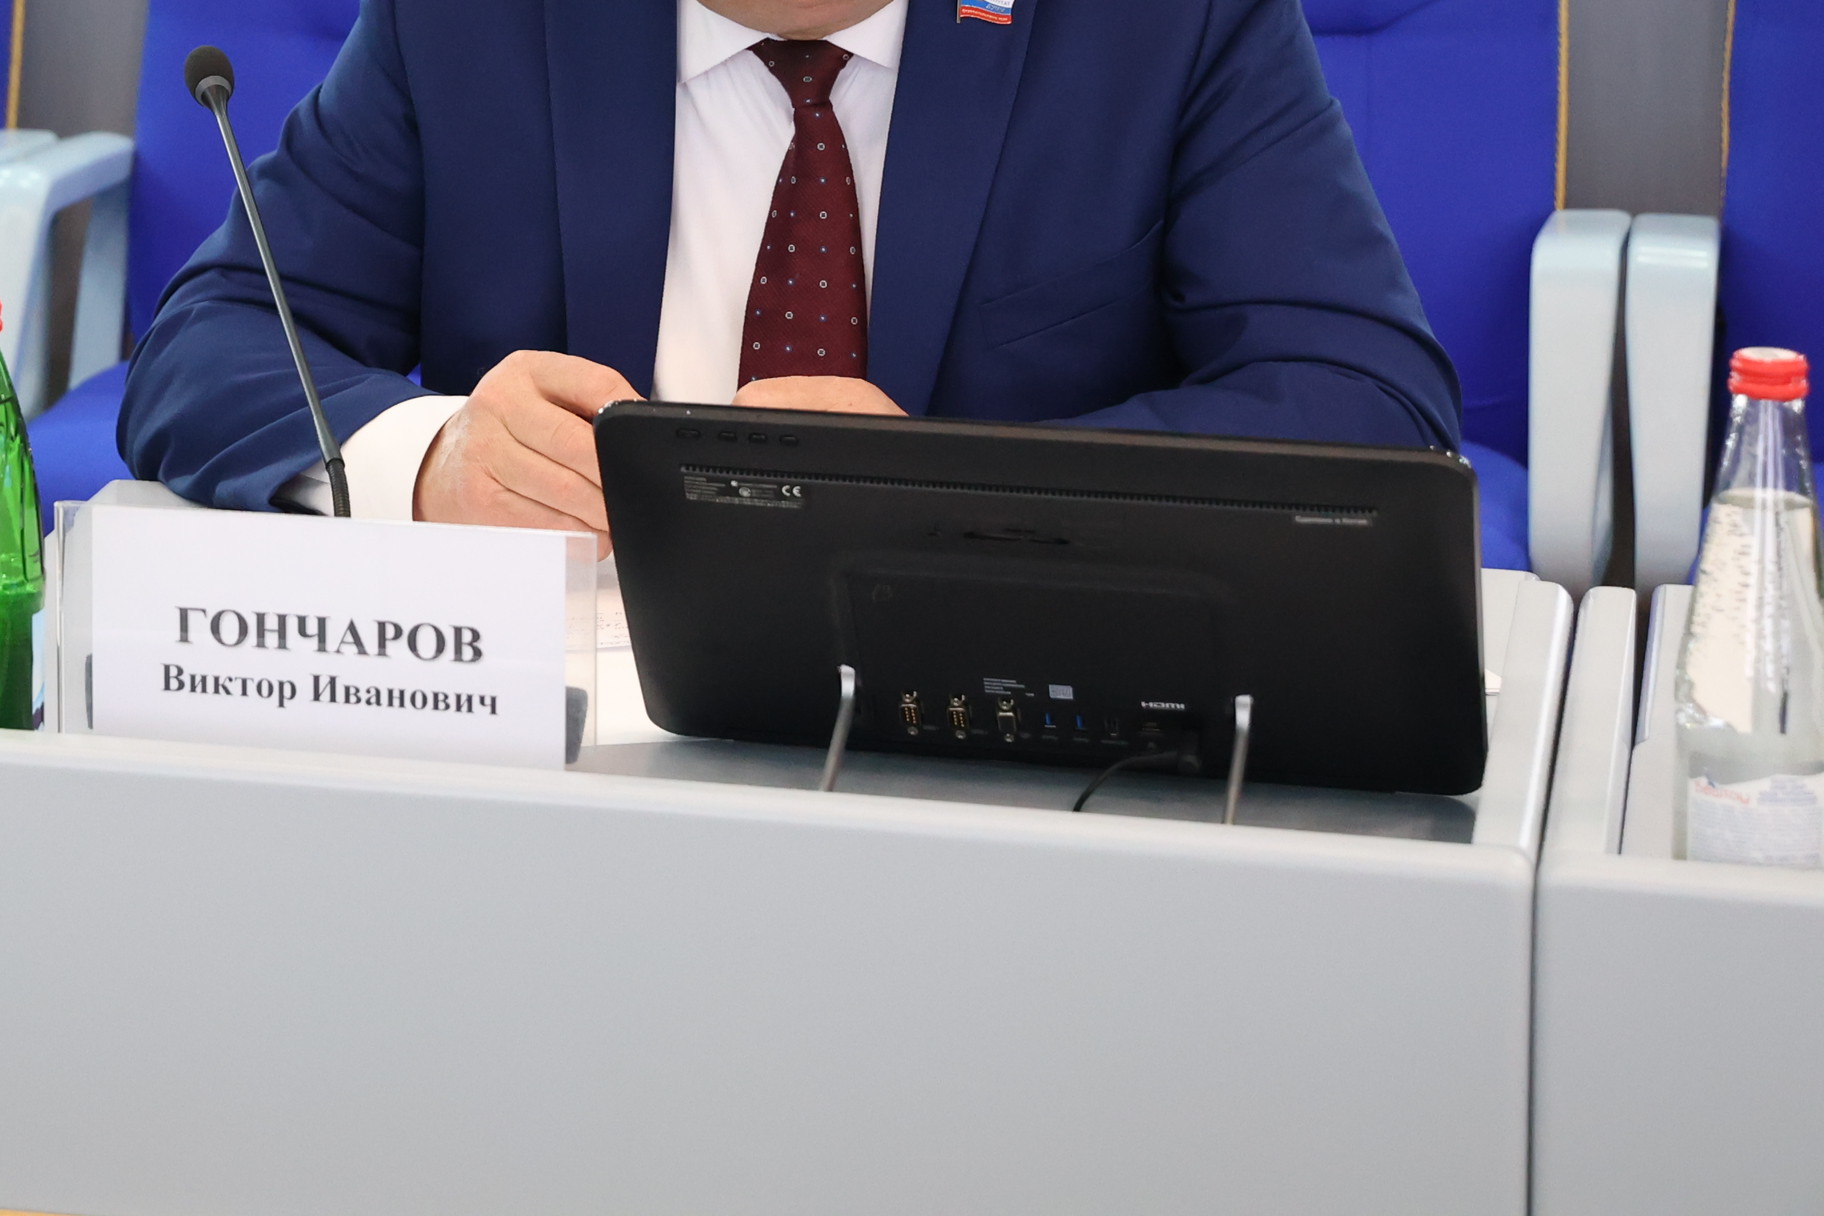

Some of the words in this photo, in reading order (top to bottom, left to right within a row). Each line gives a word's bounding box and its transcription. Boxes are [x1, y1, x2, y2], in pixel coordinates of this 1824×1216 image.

[174, 606, 484, 664] ГОНЧАРОВ
[161, 663, 297, 708] Виктор
[310, 673, 498, 715] Иванович
[1141, 701, 1186, 710] HDMI
